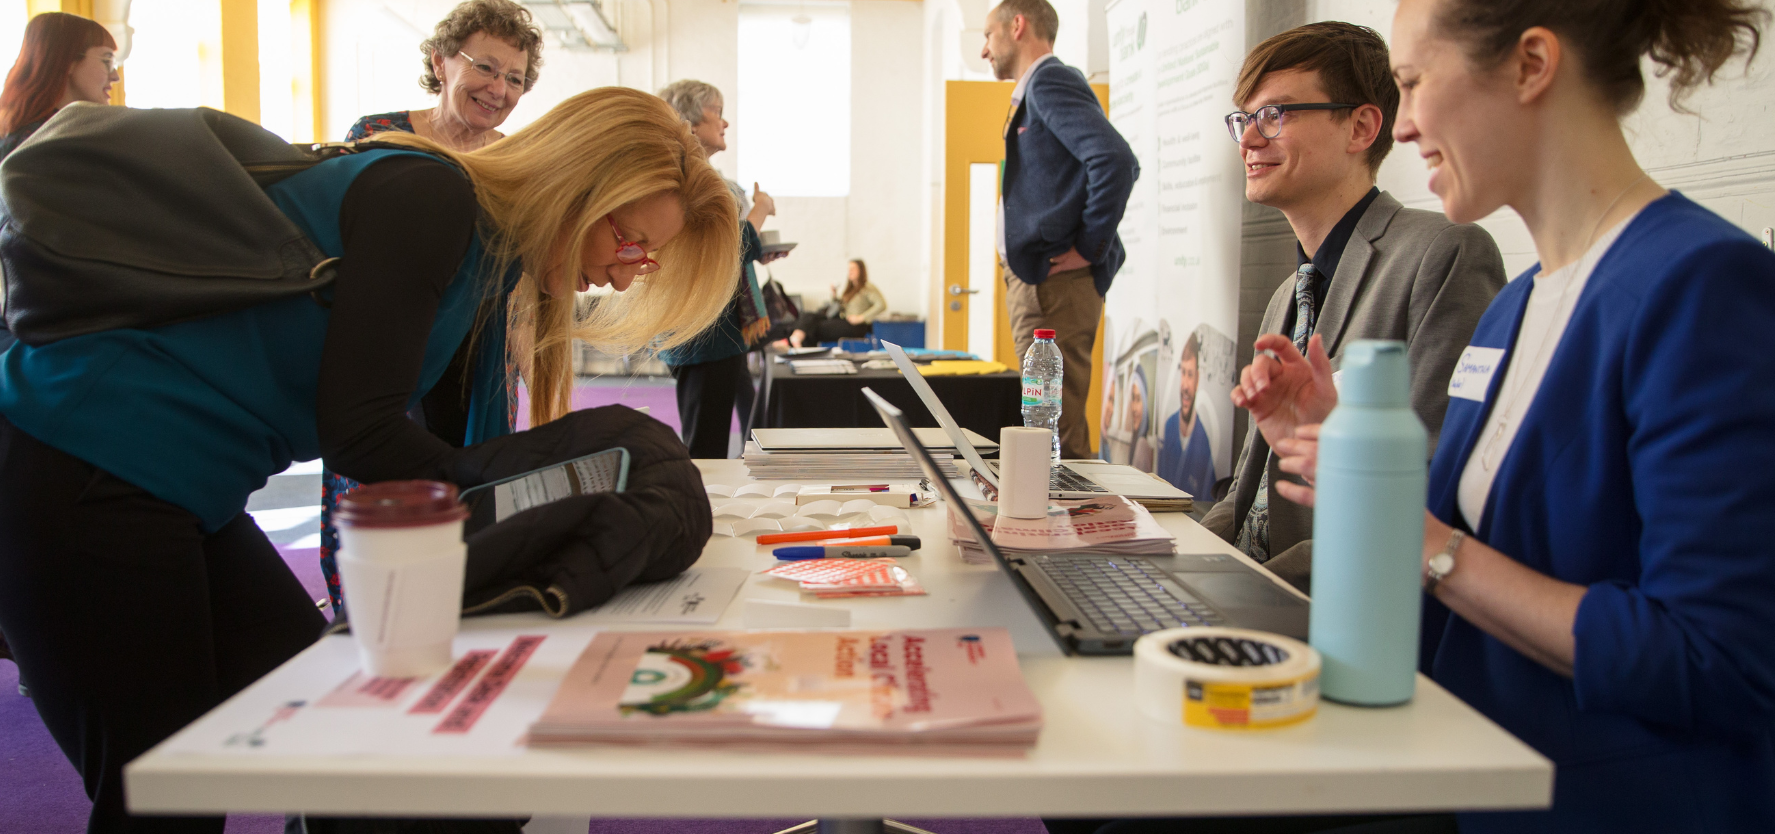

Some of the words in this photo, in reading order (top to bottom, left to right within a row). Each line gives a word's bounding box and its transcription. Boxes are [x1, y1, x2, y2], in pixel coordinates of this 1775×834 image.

[835, 636, 861, 678] Action
[868, 635, 895, 670] Local
[903, 635, 935, 713] Accelerating
